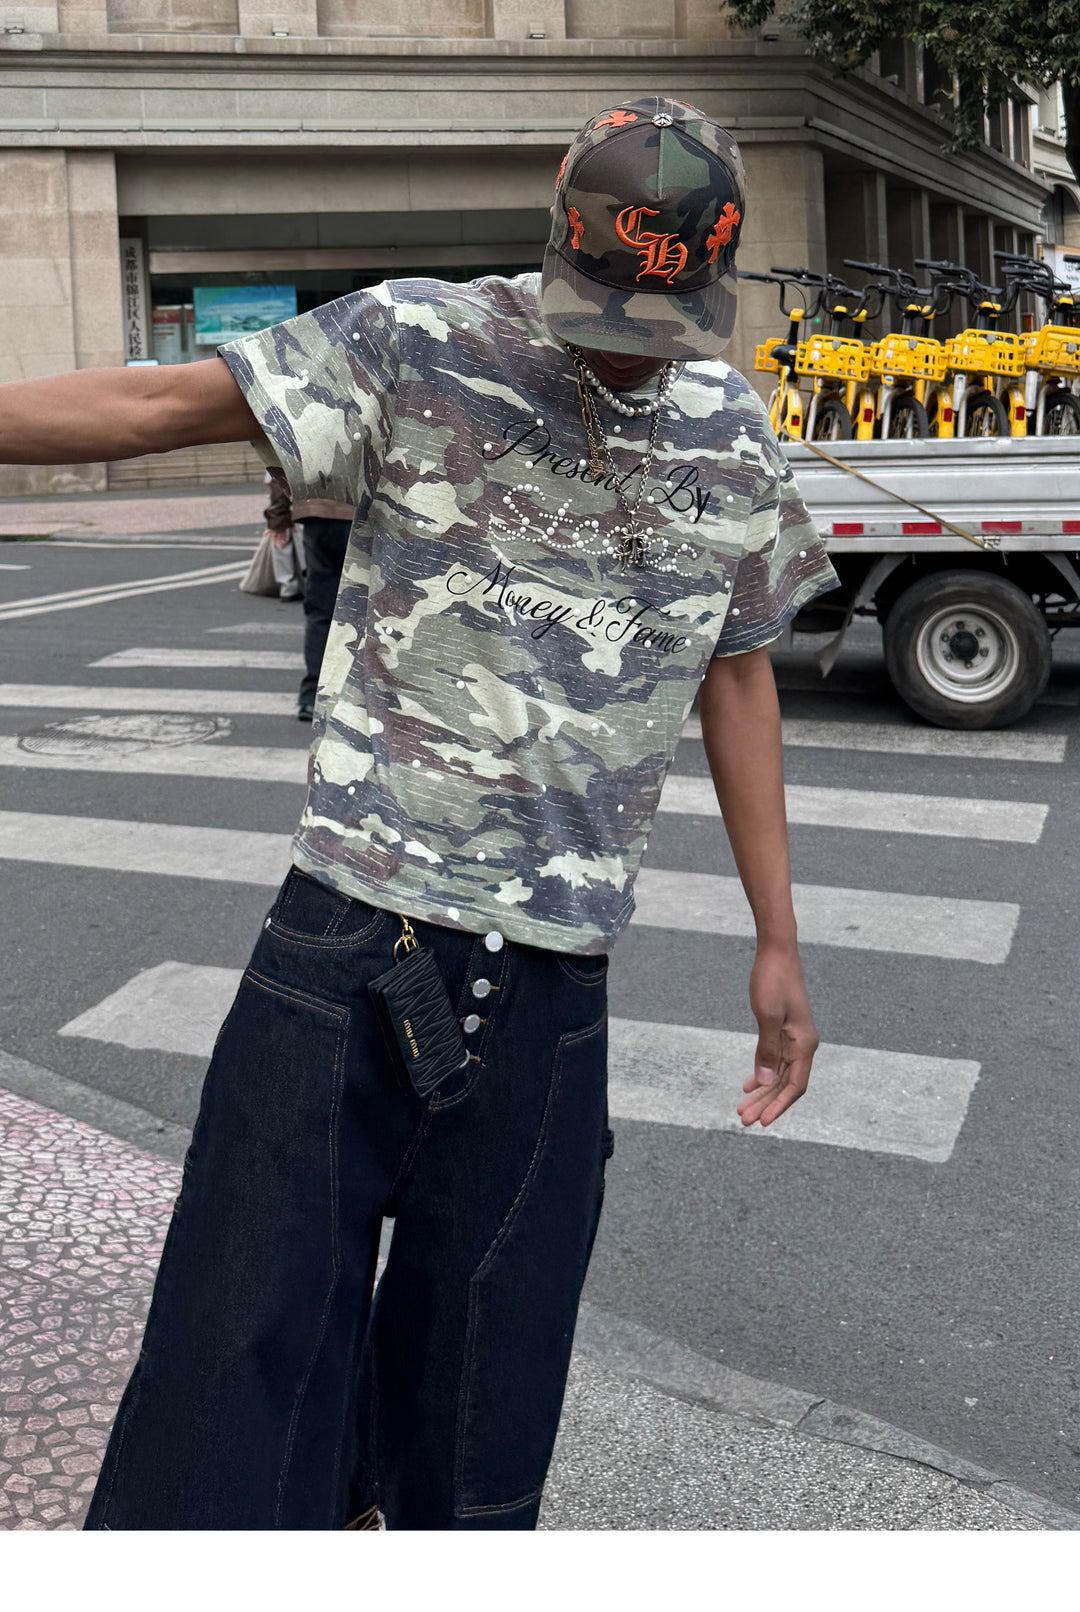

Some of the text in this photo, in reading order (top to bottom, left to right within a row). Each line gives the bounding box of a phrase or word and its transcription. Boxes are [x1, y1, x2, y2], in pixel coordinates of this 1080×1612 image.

[125, 246, 142, 360] 成都市锦江区人民检
[481, 420, 712, 524] Present By
[446, 559, 689, 654] Money & Fame
[402, 1019, 420, 1058] miu miu
